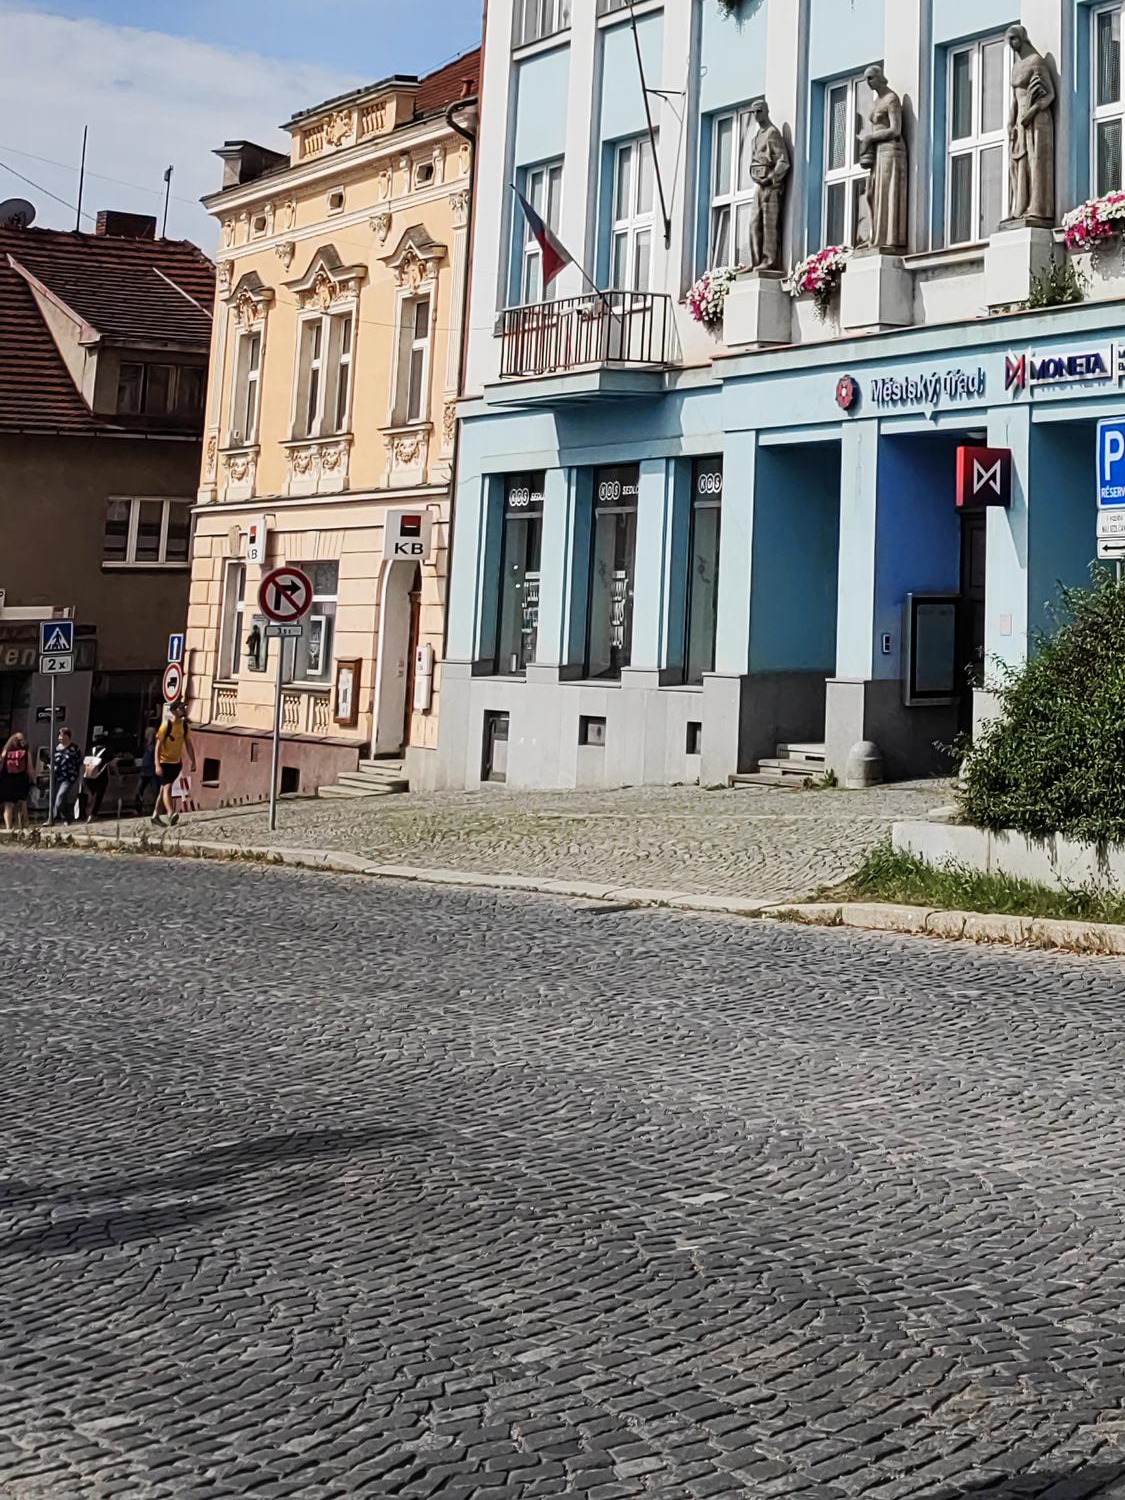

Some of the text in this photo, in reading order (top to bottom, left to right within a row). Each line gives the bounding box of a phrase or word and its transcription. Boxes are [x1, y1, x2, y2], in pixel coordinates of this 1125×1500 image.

[1030, 353, 1107, 380] MONETA
[1105, 430, 1125, 481] P
[599, 481, 620, 500] KDS
[698, 473, 722, 493] KDS
[394, 542, 424, 555] KB
[48, 659, 56, 671] 2
